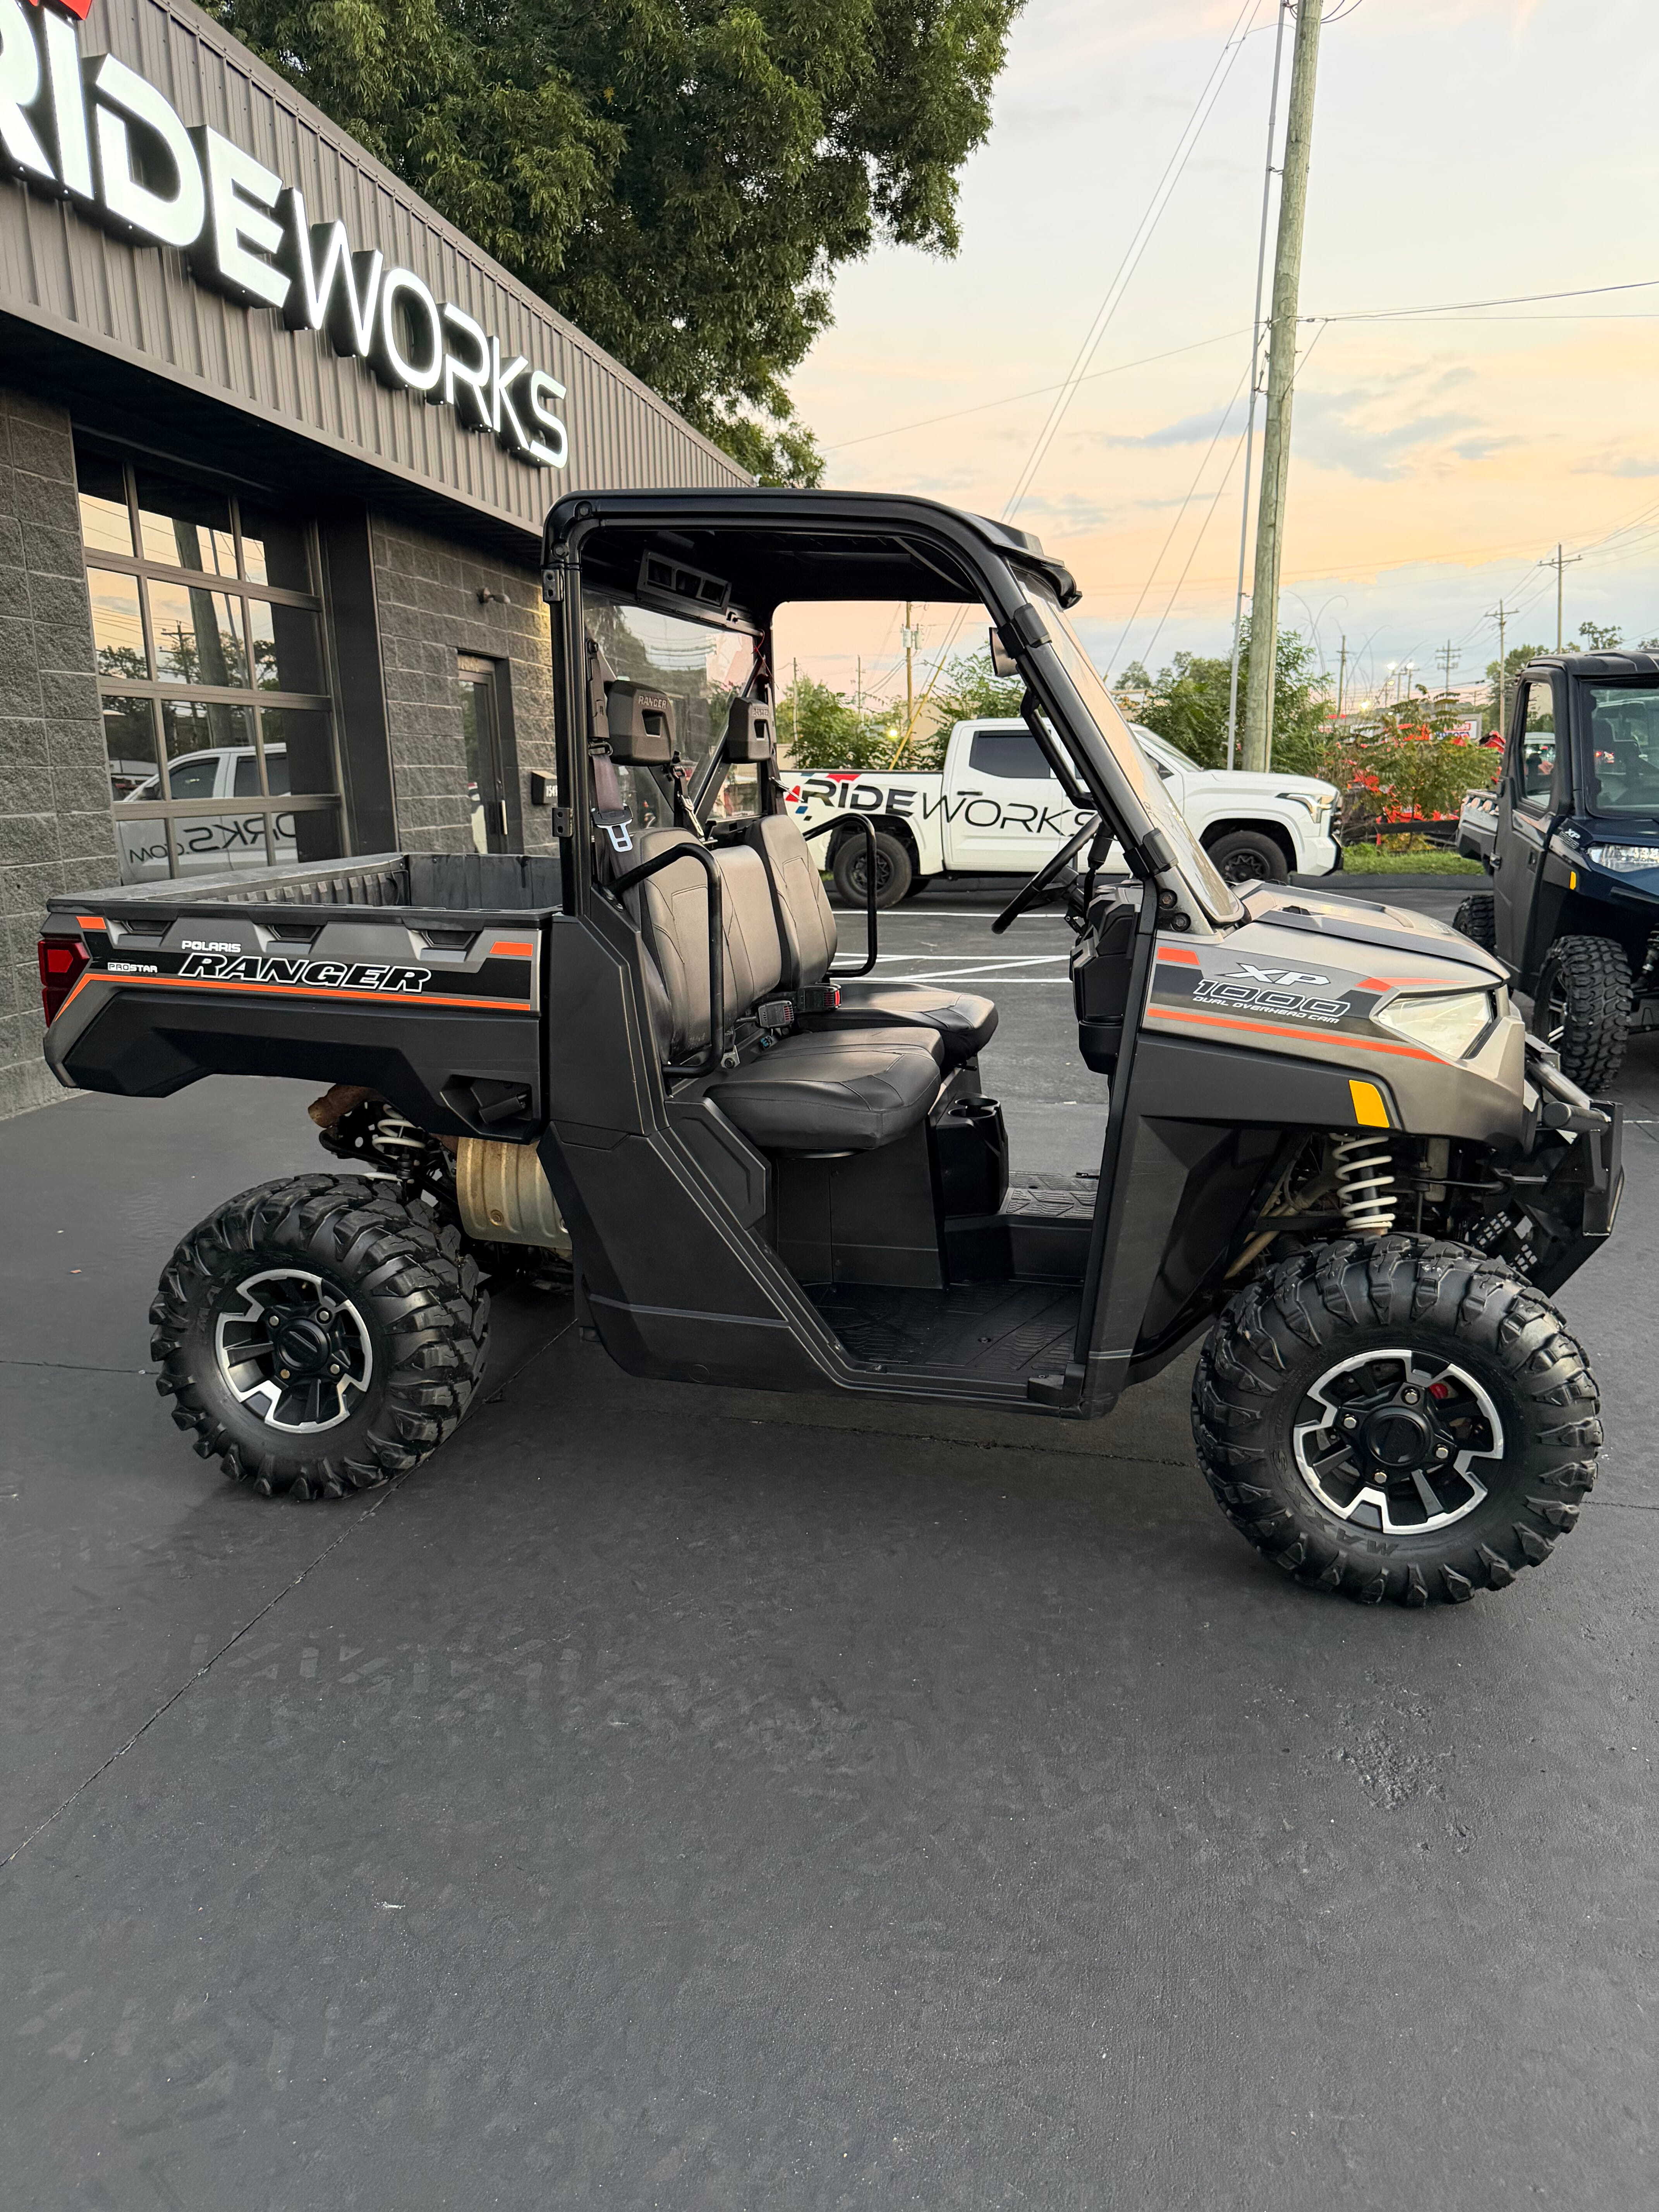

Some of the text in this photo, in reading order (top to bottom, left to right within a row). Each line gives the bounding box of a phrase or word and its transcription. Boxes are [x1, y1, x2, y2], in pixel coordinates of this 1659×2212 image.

[639, 695, 667, 709] RANGER
[1565, 828, 1581, 839] XP
[182, 940, 241, 953] POLARIS
[178, 953, 431, 992] RANGER
[1215, 962, 1331, 986] XP
[1193, 979, 1351, 1017] 1000
[1193, 996, 1340, 1024] DUAL OVERHEAD CAM
